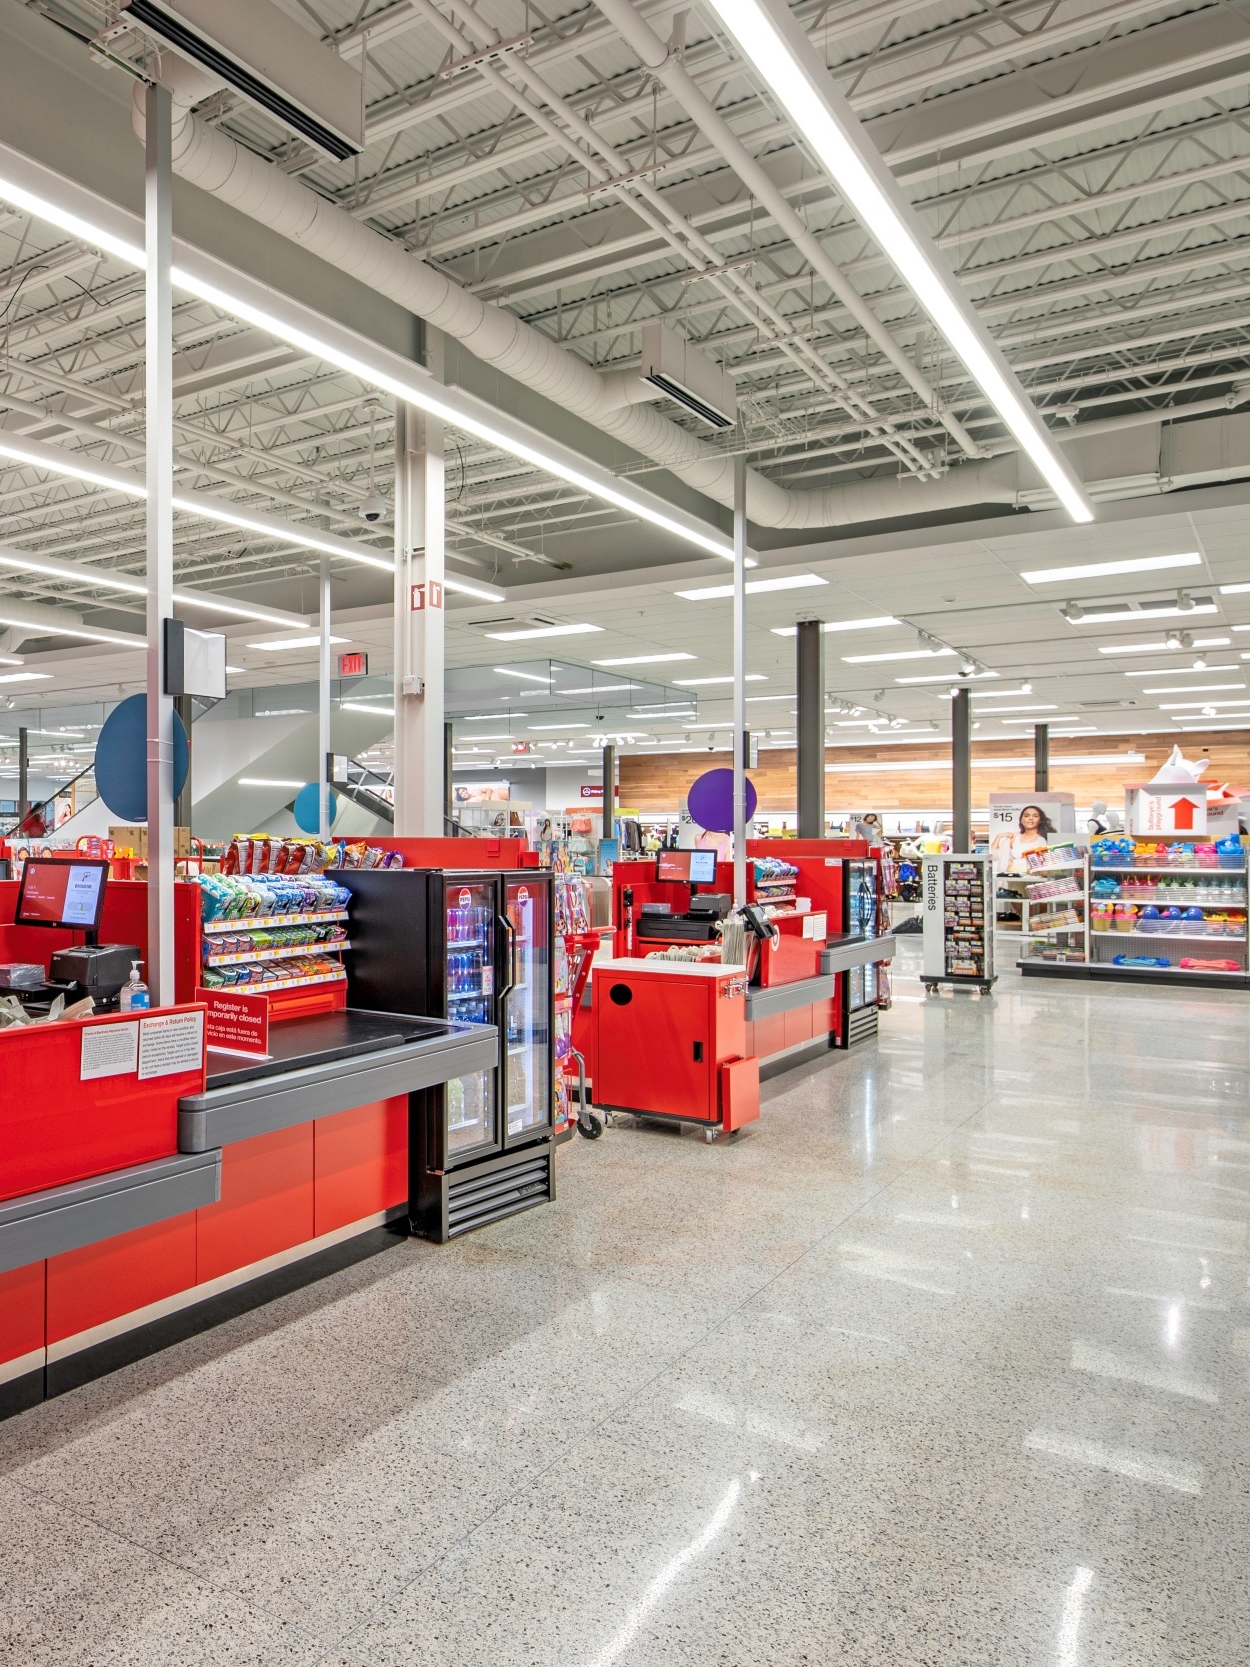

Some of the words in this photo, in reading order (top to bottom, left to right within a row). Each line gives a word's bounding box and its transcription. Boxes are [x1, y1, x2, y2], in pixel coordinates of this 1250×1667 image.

[342, 654, 363, 676] EXIT
[993, 812, 1013, 822] $15
[928, 864, 938, 911] Batteries
[214, 1001, 241, 1011] Register
[207, 1010, 238, 1021] mporarily
[239, 1014, 262, 1024] closed
[237, 1036, 262, 1044] momento.
